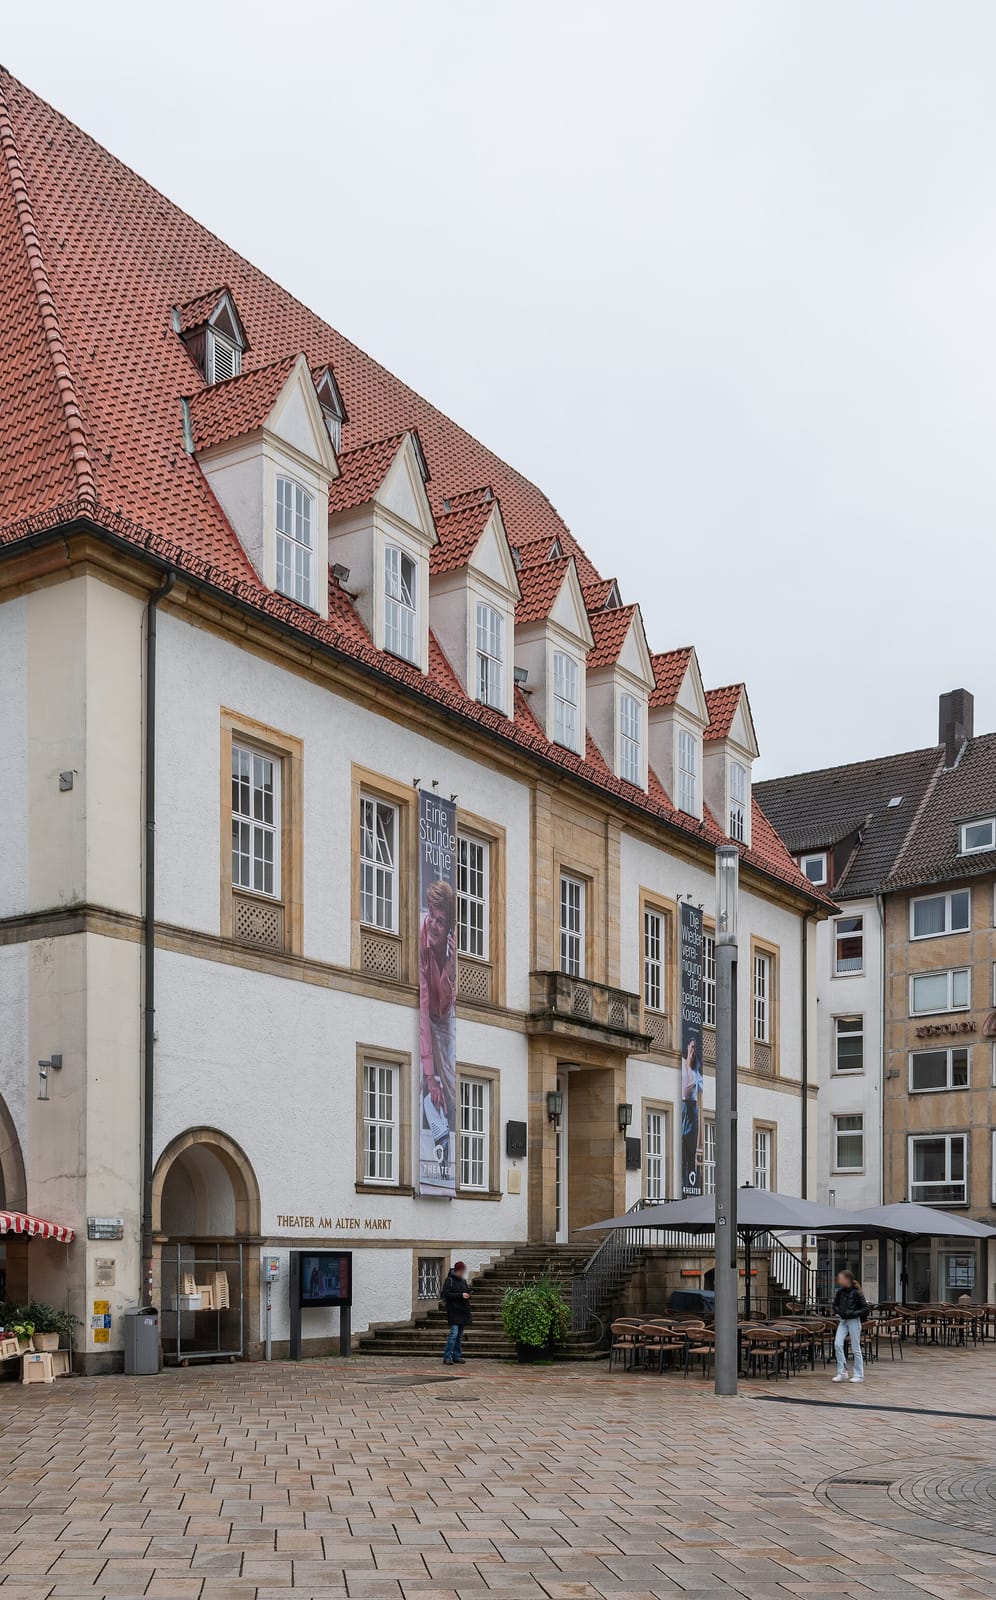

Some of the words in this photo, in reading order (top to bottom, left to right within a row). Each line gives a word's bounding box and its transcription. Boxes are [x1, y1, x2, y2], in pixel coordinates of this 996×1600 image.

[426, 800, 447, 828] Eine
[420, 818, 456, 851] Stunde
[425, 842, 451, 871] Ruhe
[690, 911, 699, 930] Die
[681, 959, 702, 980] nigung
[690, 974, 700, 991] der
[681, 987, 702, 1009] beiden
[681, 1004, 702, 1025] Koreas
[424, 1165, 452, 1175] THEATER
[683, 1187, 701, 1195] THEATER
[277, 1215, 315, 1227] THEATER
[319, 1217, 332, 1229] AM
[336, 1218, 360, 1229] ALTEN
[364, 1219, 392, 1230] MARKT
